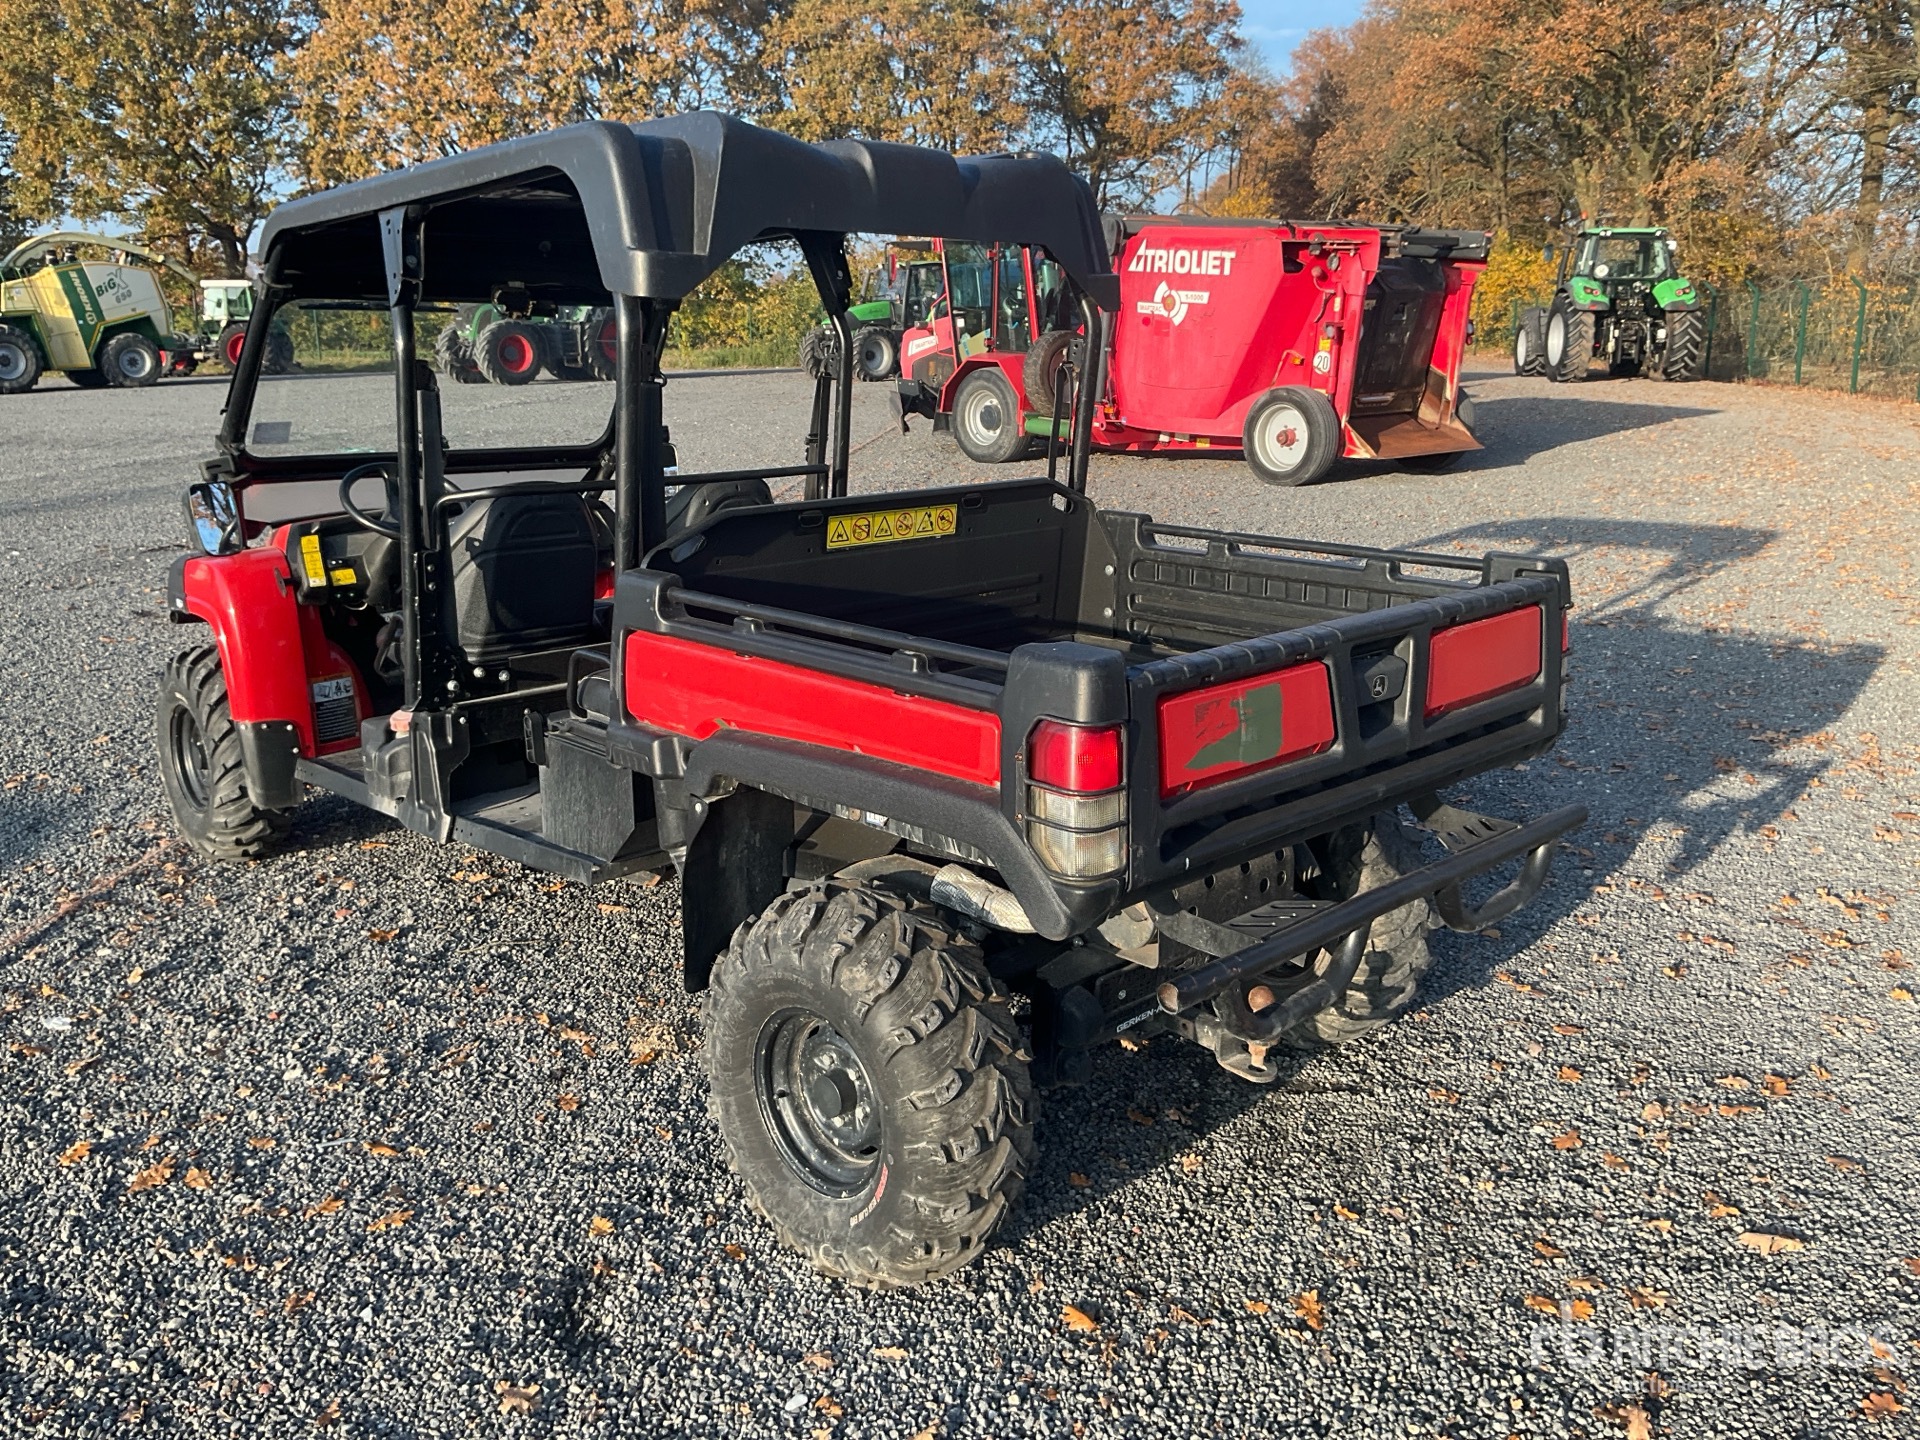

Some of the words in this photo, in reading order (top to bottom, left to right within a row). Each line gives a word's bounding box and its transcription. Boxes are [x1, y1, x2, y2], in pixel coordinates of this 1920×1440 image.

[68, 270, 93, 311] KRONE
[115, 289, 133, 304] 650
[1317, 354, 1329, 370] 20
